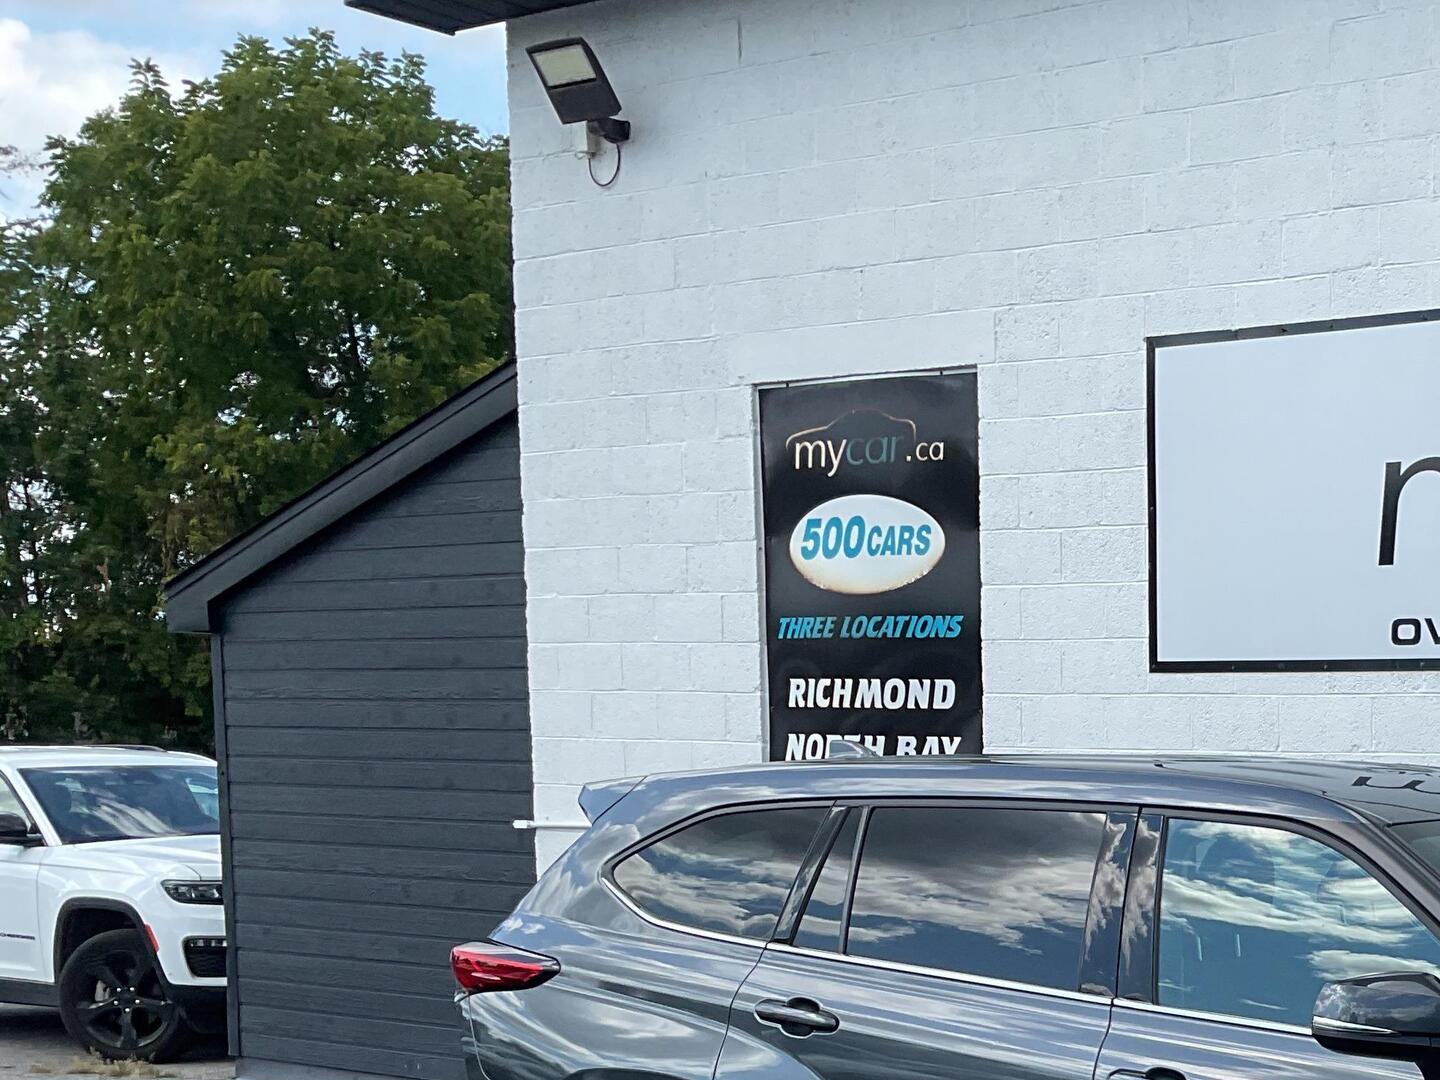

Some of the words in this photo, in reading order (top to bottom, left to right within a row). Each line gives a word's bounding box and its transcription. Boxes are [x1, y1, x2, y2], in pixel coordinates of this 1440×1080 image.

[777, 615, 837, 640] THREE
[839, 614, 965, 639] LOCATIONS
[787, 677, 957, 710] RICHMOND
[784, 732, 886, 762] NOH
[896, 735, 963, 757] BAY
